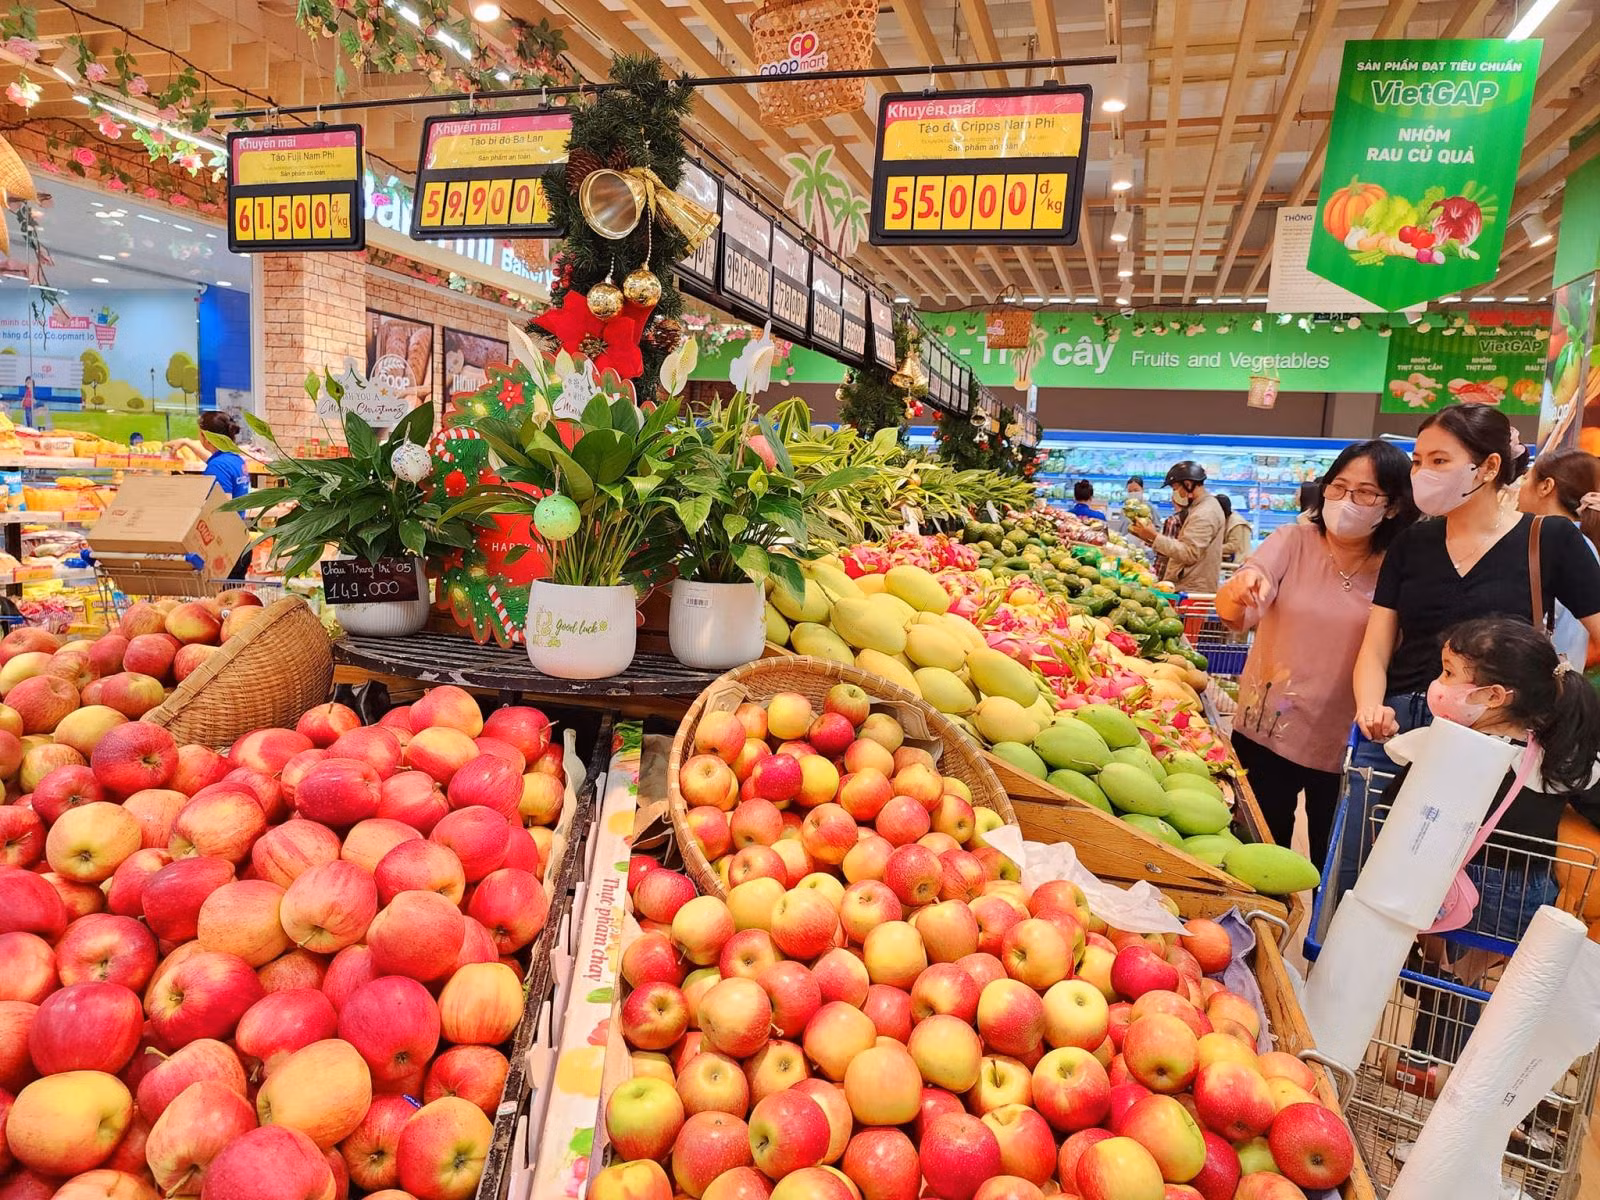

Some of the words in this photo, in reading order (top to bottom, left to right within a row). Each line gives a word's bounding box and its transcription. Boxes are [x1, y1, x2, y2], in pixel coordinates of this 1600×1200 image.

[1422, 62, 1446, 74] ĐẠT
[1450, 60, 1477, 72] TIÊU
[1371, 79, 1498, 106] VietGAP
[918, 123, 939, 134] Táo
[961, 120, 1000, 134] Cripps
[1004, 118, 1032, 129] Nam
[513, 136, 525, 144] Ba
[527, 134, 544, 143] Lan
[287, 152, 302, 163] Fuji
[303, 152, 320, 160] Nam
[1366, 147, 1403, 162] RAU
[1407, 145, 1432, 162] CỦ
[1437, 146, 1475, 164] QUẢ
[426, 185, 530, 219] 59.900
[892, 181, 1027, 220] 55.000
[239, 201, 327, 232] 61.500
[1052, 336, 1116, 374] cây
[1131, 350, 1180, 368] Fruits
[1188, 351, 1221, 368] and
[1229, 351, 1330, 372] Vegetables
[1480, 340, 1543, 353] VietGAP
[396, 562, 412, 573] 05
[327, 581, 400, 600] 149.000
[583, 949, 609, 982] chay
